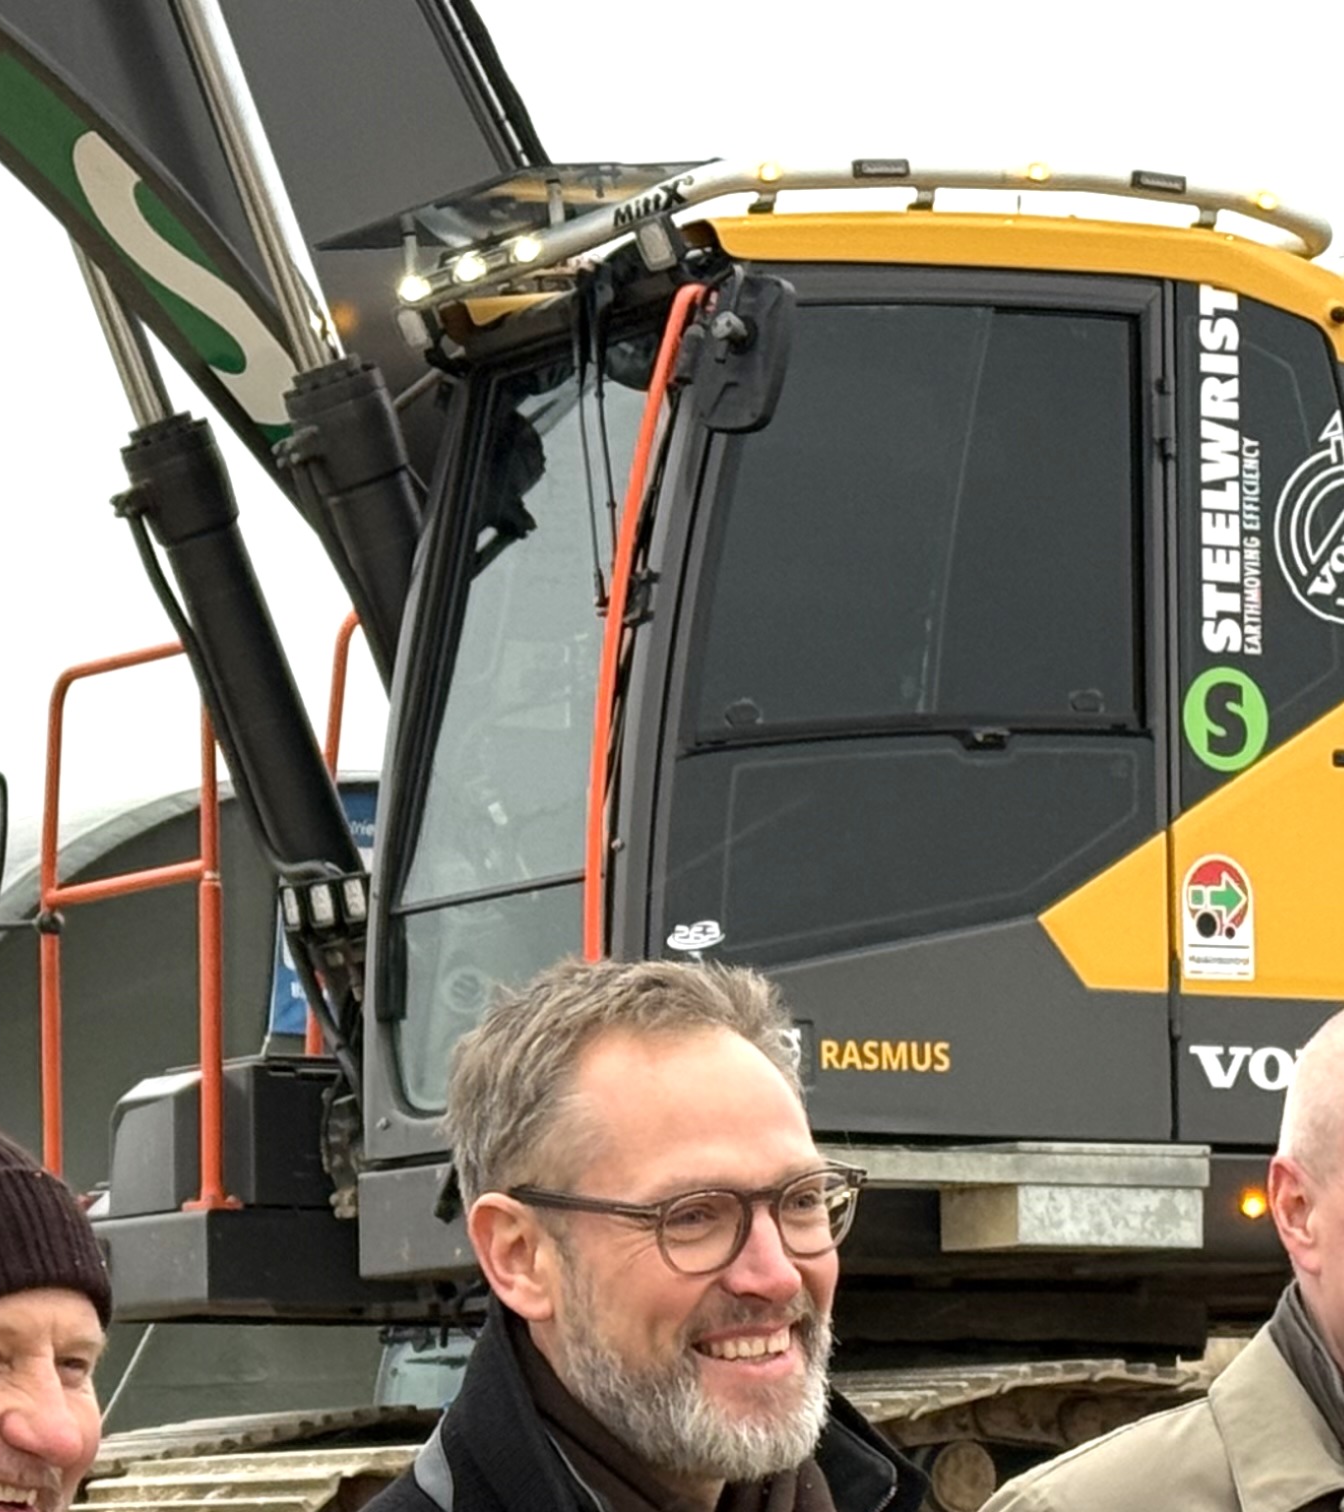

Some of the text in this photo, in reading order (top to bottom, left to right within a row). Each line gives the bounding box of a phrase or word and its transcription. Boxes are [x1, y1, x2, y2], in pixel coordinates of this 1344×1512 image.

[1199, 284, 1242, 655] STEELWRIST
[1243, 436, 1262, 655] EARTHMOVING EFFICIENCY
[820, 1039, 951, 1072] RASMUS
[1188, 1045, 1304, 1091] VO
